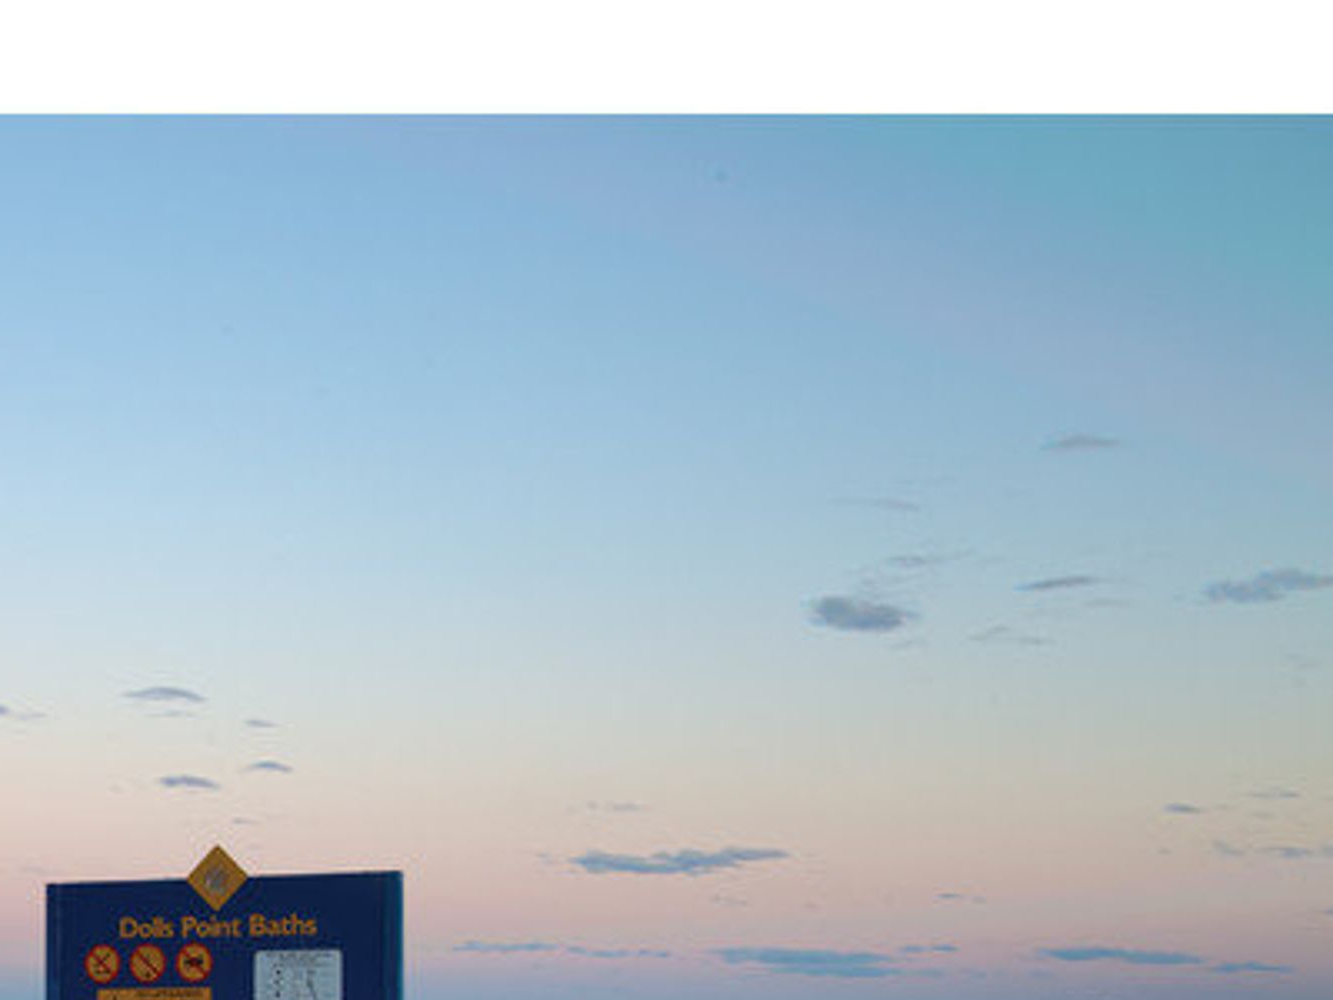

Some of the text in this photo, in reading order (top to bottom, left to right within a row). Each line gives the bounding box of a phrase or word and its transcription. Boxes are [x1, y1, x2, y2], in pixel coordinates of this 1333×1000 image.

[118, 912, 317, 938] Dolls Point Baths
